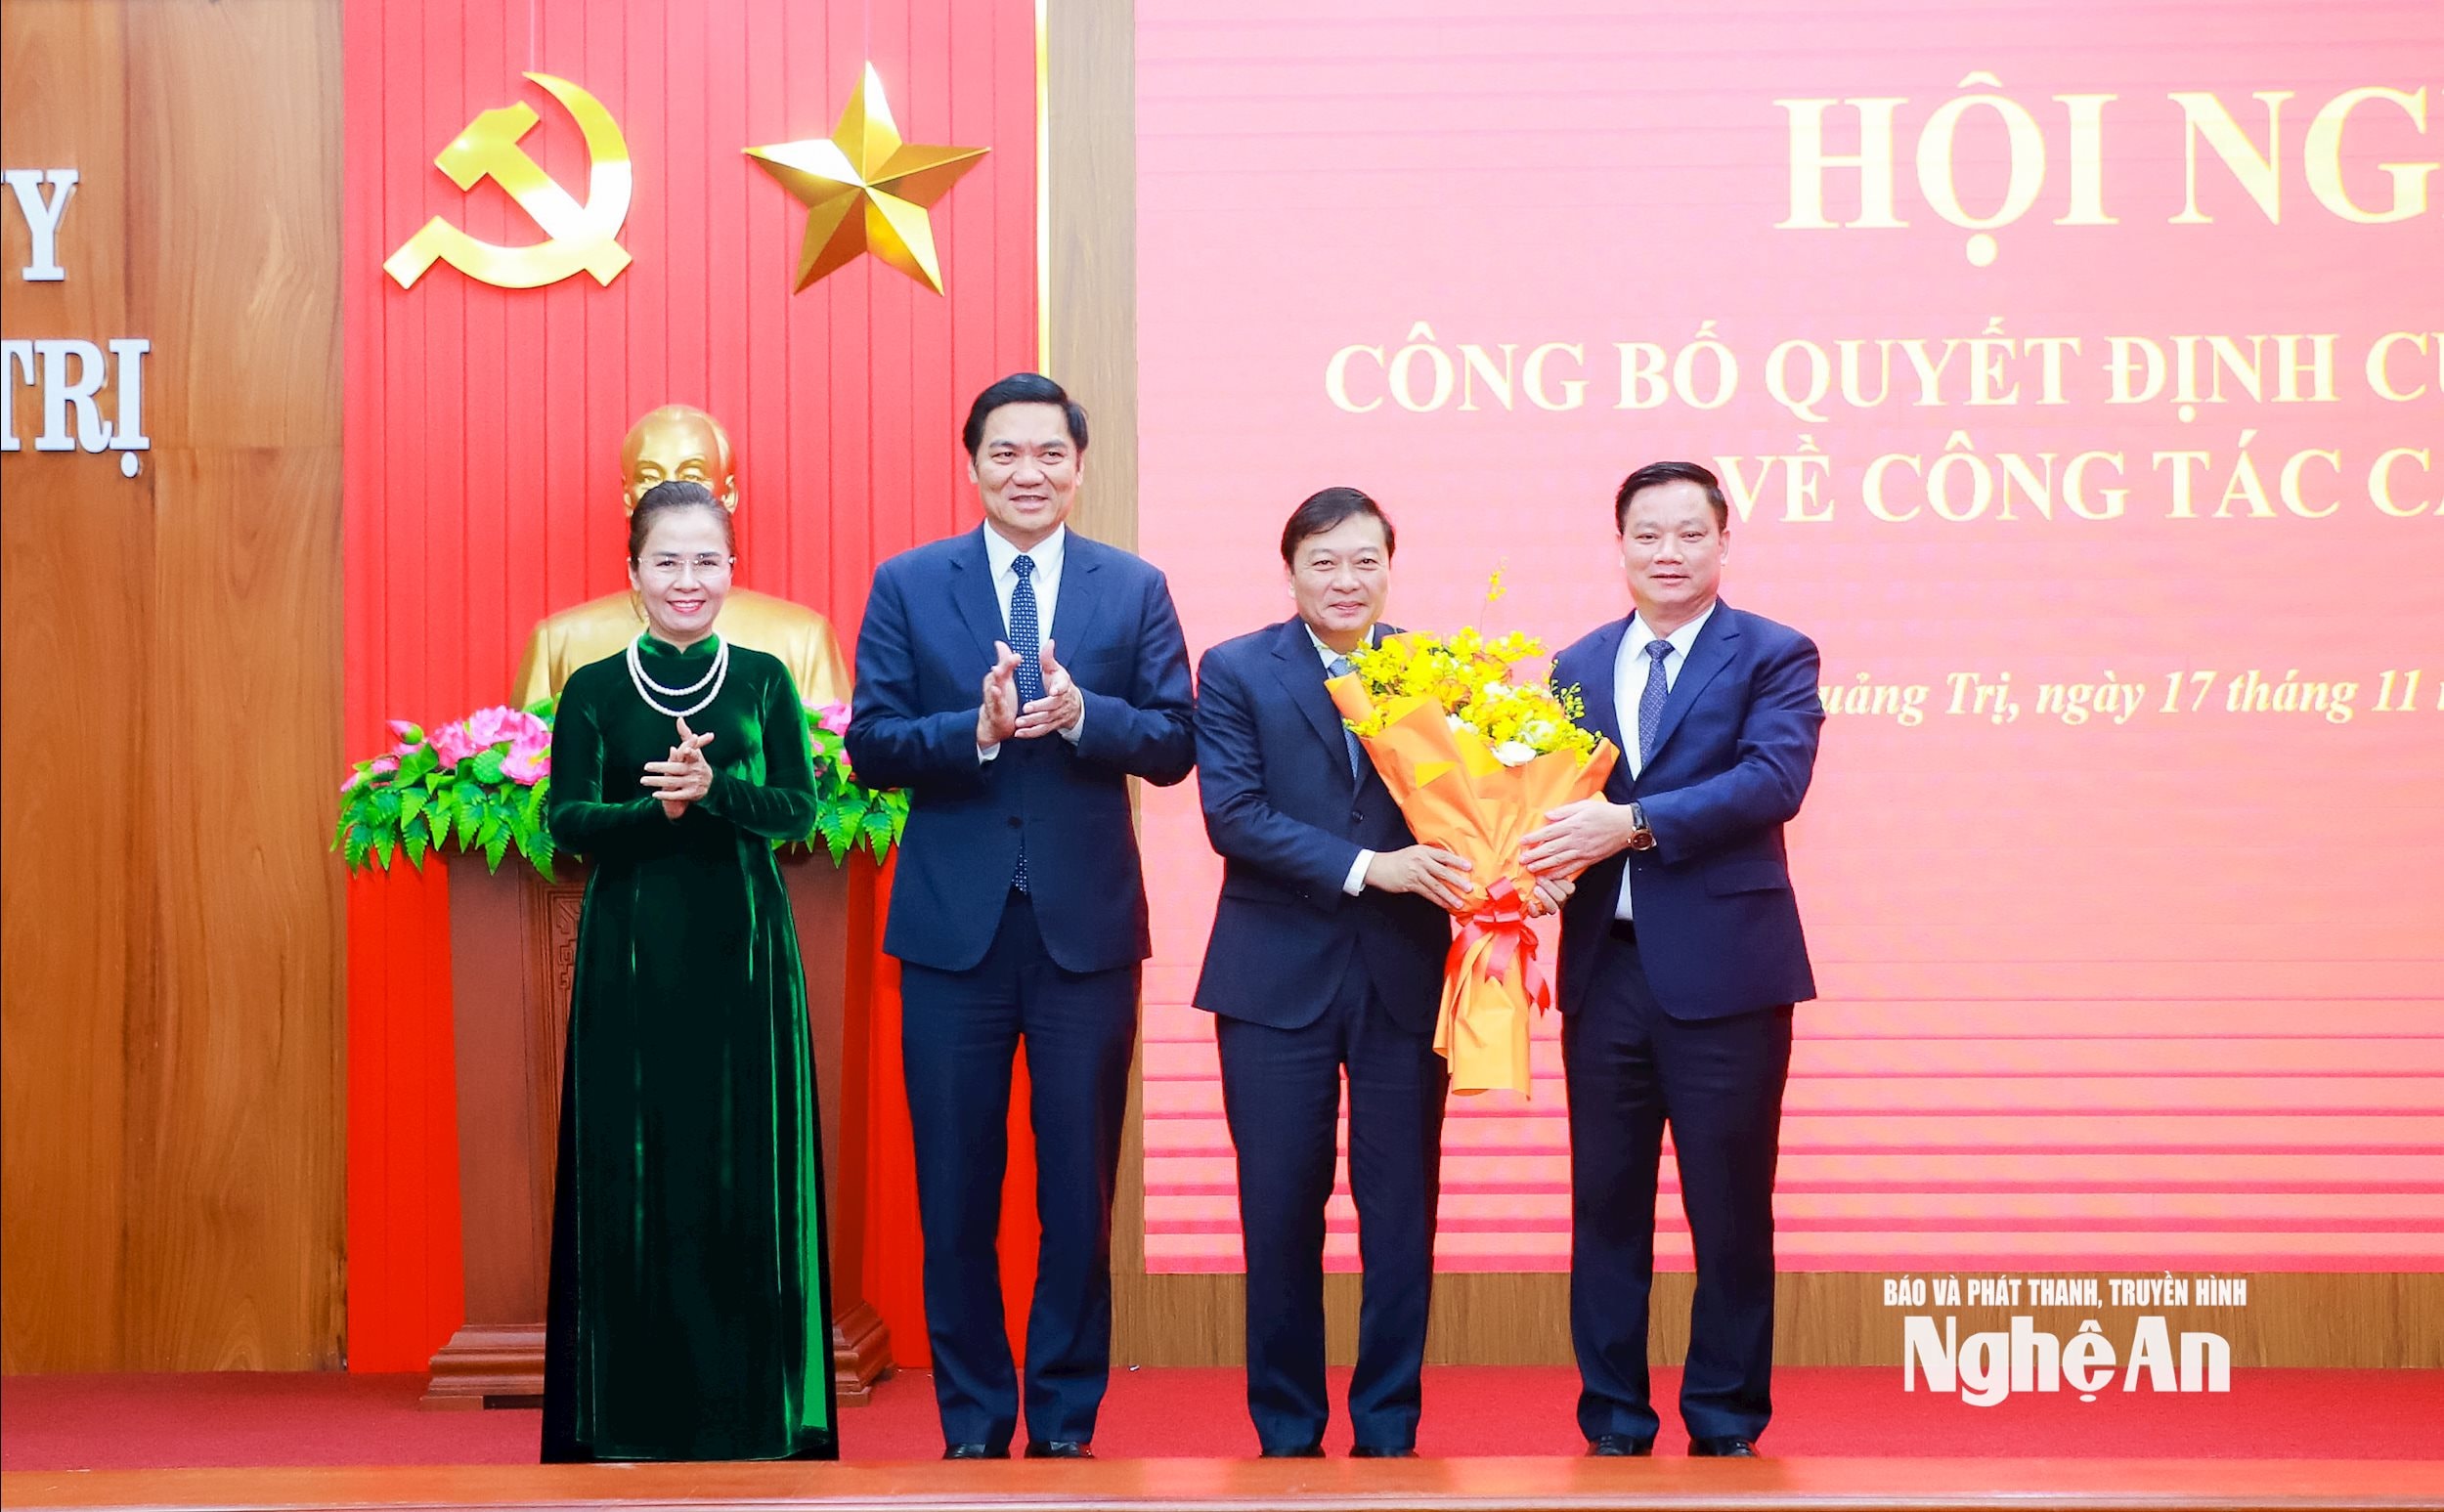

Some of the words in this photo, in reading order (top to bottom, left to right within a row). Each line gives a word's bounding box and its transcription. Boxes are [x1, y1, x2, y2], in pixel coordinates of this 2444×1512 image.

[1771, 70, 2119, 268] HỘI
[2166, 86, 2444, 226] NG
[1, 168, 79, 281] Y
[1325, 321, 1590, 414] CÔNG
[1612, 320, 1739, 410] BỐ
[1765, 316, 2081, 423] QUYẾT
[2102, 333, 2340, 423] ĐỊNH
[1713, 433, 1835, 523] VỀ
[1861, 429, 2130, 523] CÔNG
[2152, 428, 2341, 519] TÁC
[1818, 671, 1931, 727] uảng
[1944, 671, 2021, 725] Trị,
[2035, 670, 2146, 726] ngày
[2160, 670, 2217, 713] 17
[2226, 669, 2359, 724] tháng
[2371, 669, 2421, 712] 11
